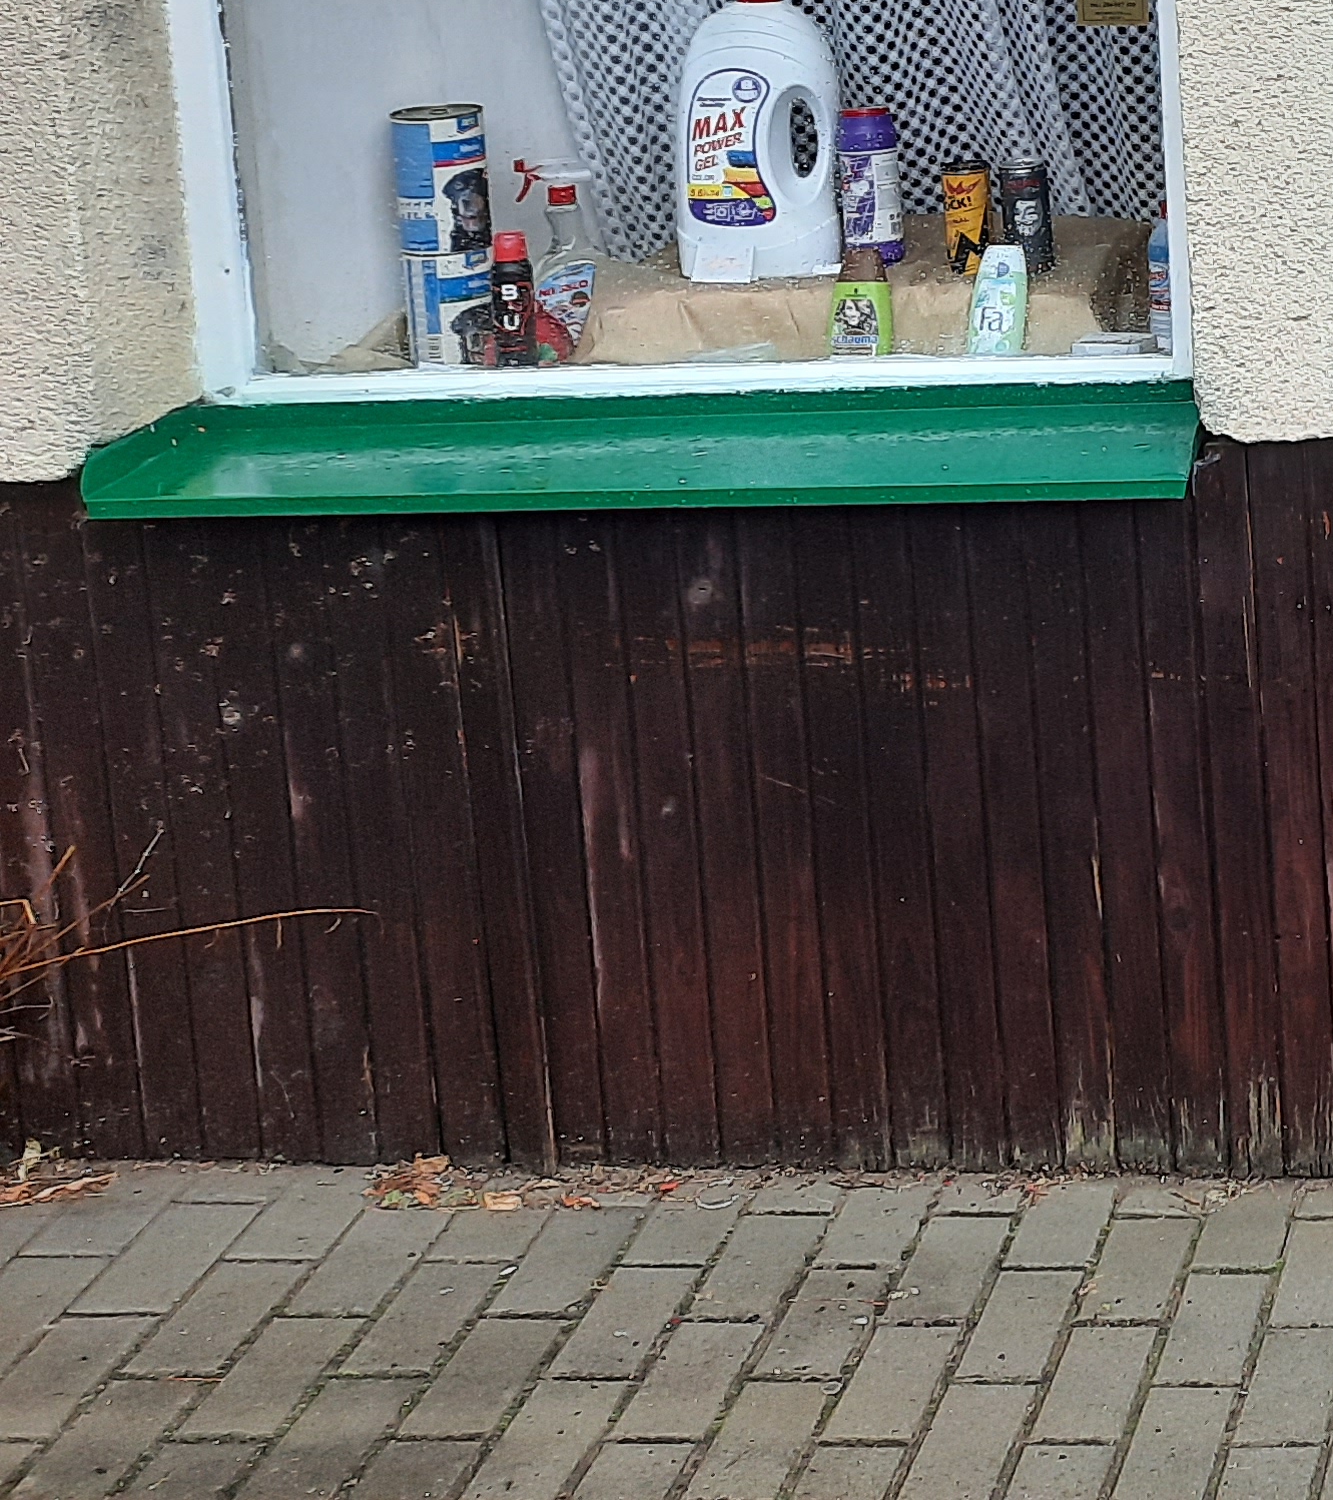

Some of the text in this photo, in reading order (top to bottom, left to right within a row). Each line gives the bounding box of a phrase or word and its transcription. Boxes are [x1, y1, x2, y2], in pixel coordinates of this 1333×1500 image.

[691, 105, 747, 142] MAX
[693, 131, 745, 158] POWER
[694, 154, 720, 172] GEL
[979, 306, 1004, 332] Fa
